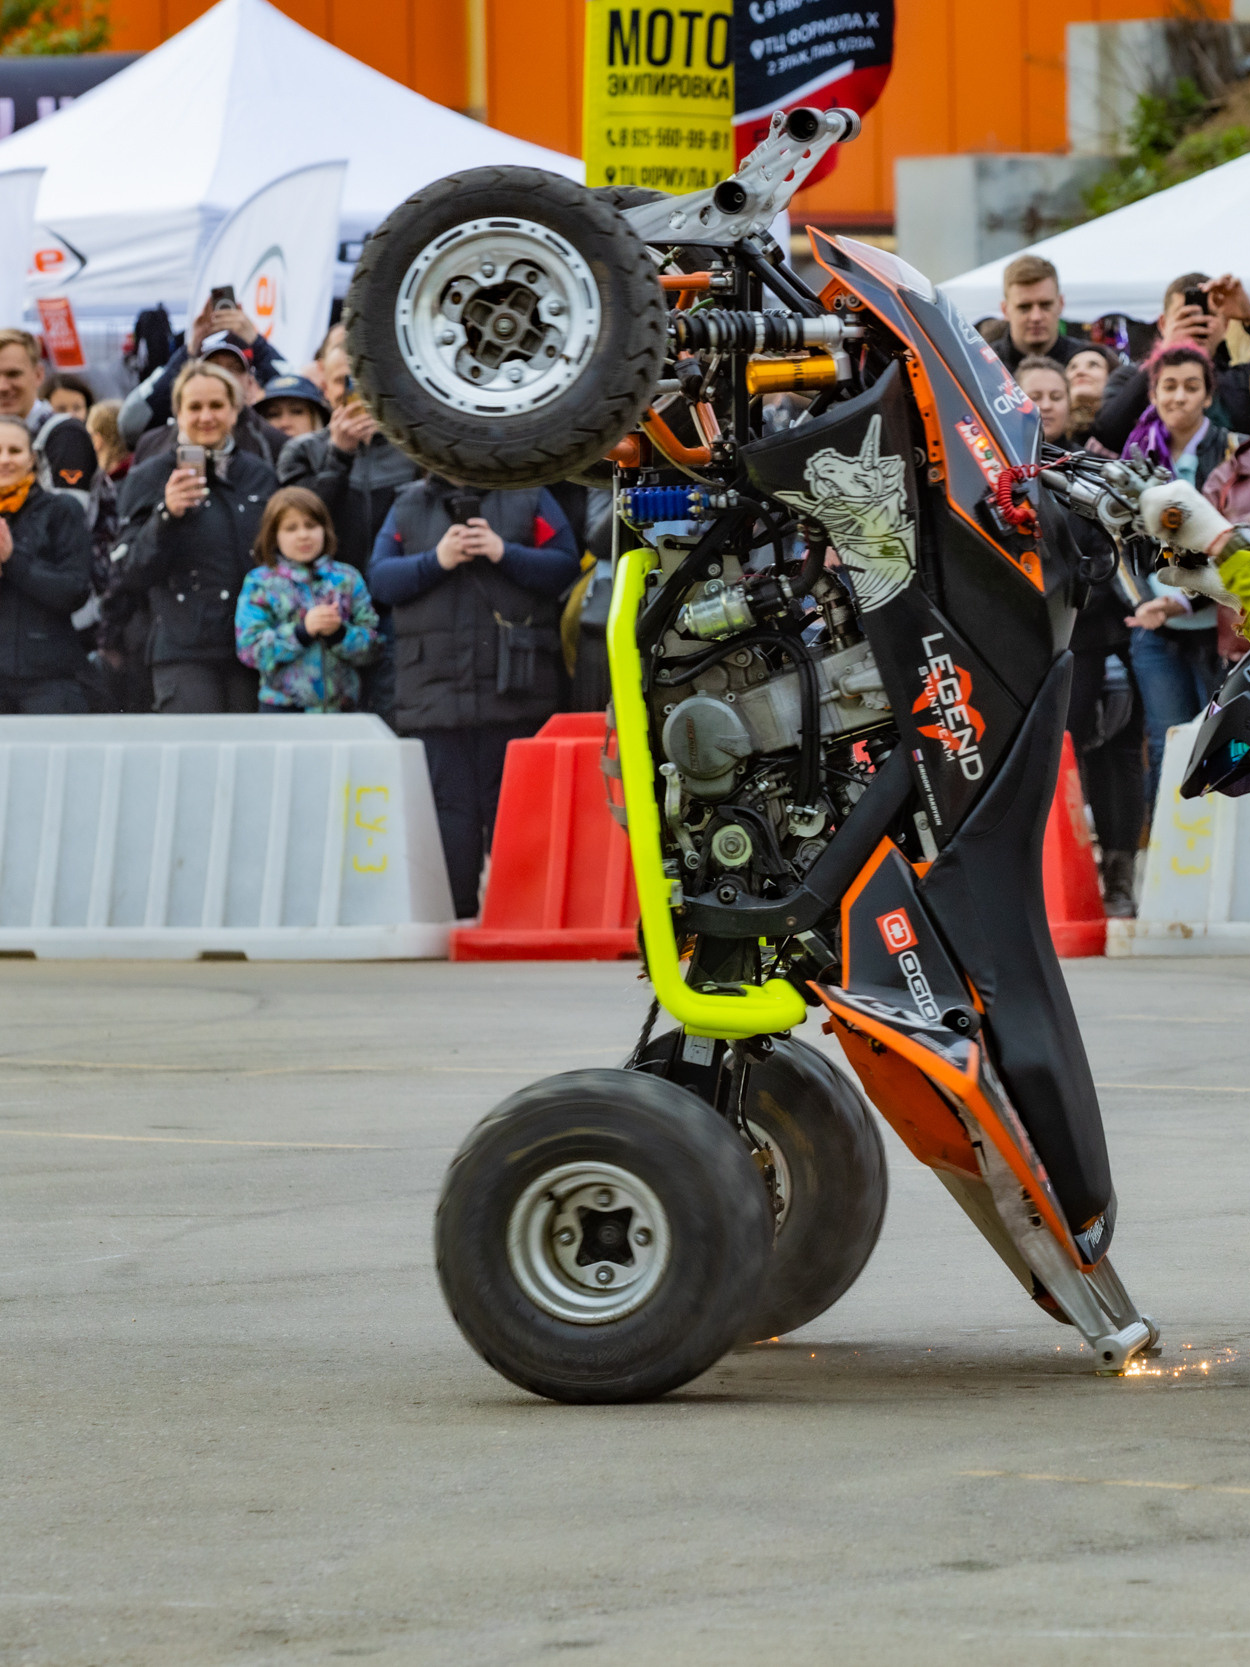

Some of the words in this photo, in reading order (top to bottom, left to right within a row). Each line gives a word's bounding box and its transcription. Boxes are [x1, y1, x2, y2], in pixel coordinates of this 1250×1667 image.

[608, 8, 731, 70] МОТО
[608, 73, 730, 99] ЭКИПИРОВКА
[921, 632, 984, 781] LEGEND
[935, 718, 956, 762] TEAM
[898, 950, 942, 1022] OGIO
